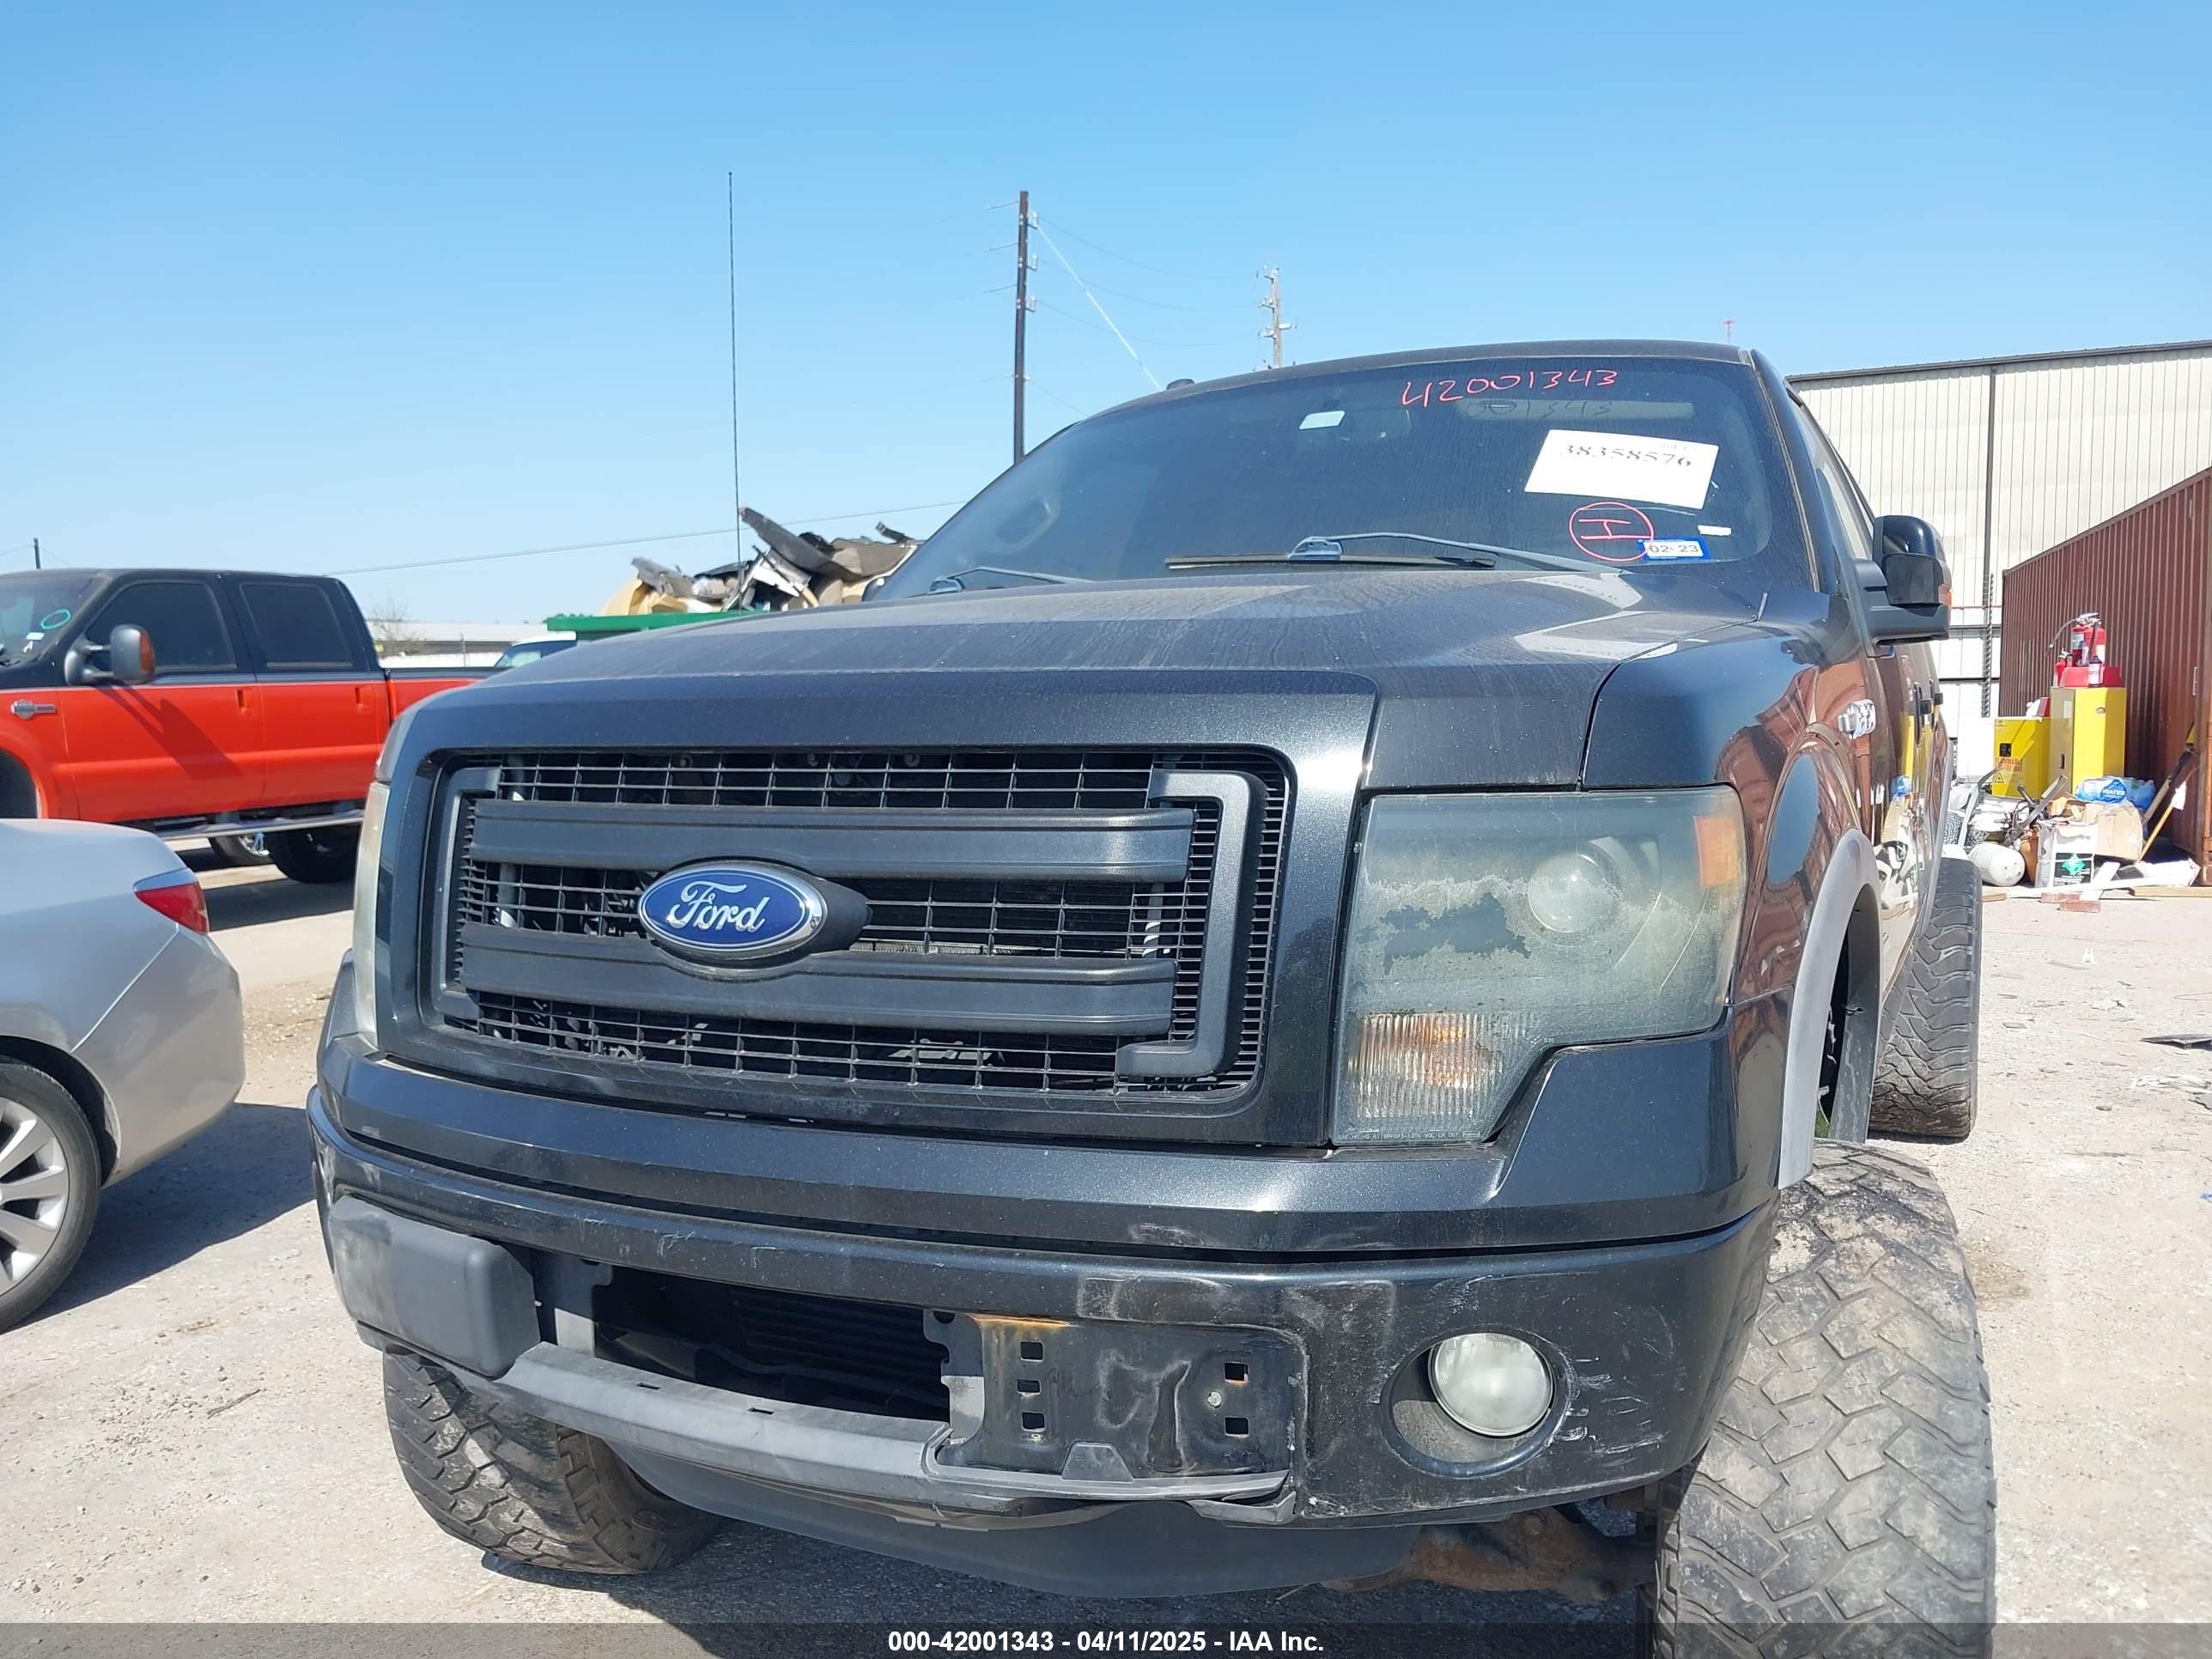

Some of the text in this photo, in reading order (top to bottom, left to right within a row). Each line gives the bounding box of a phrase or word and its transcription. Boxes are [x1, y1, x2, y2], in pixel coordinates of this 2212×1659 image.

[1401, 369, 1619, 408] 42001343
[1561, 444, 1692, 467] 38358576
[2102, 788, 2126, 797] WATER
[665, 880, 771, 933] Ford
